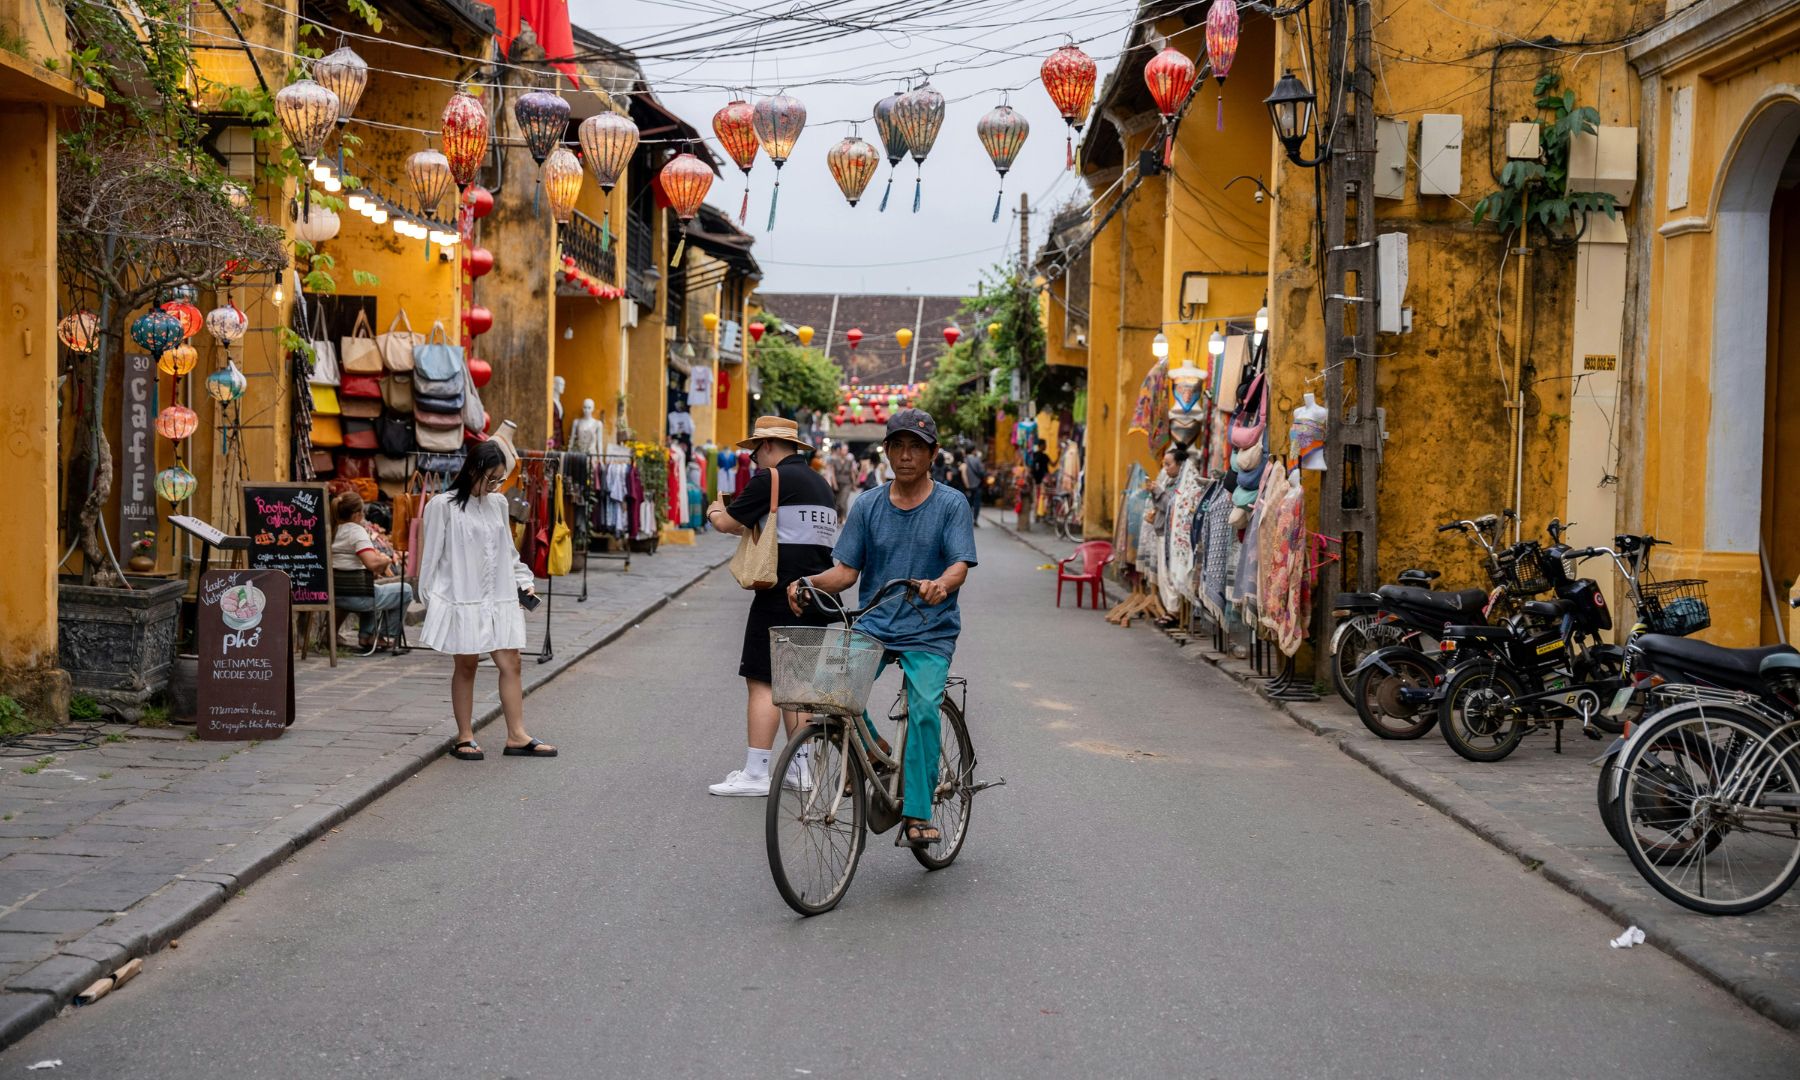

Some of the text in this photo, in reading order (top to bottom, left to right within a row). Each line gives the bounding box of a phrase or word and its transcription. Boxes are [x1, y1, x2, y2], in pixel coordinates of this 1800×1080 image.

[133, 356, 150, 369] 30
[213, 658, 273, 669] VIETNAMESE
[213, 670, 273, 680] NOODLE SOUP
